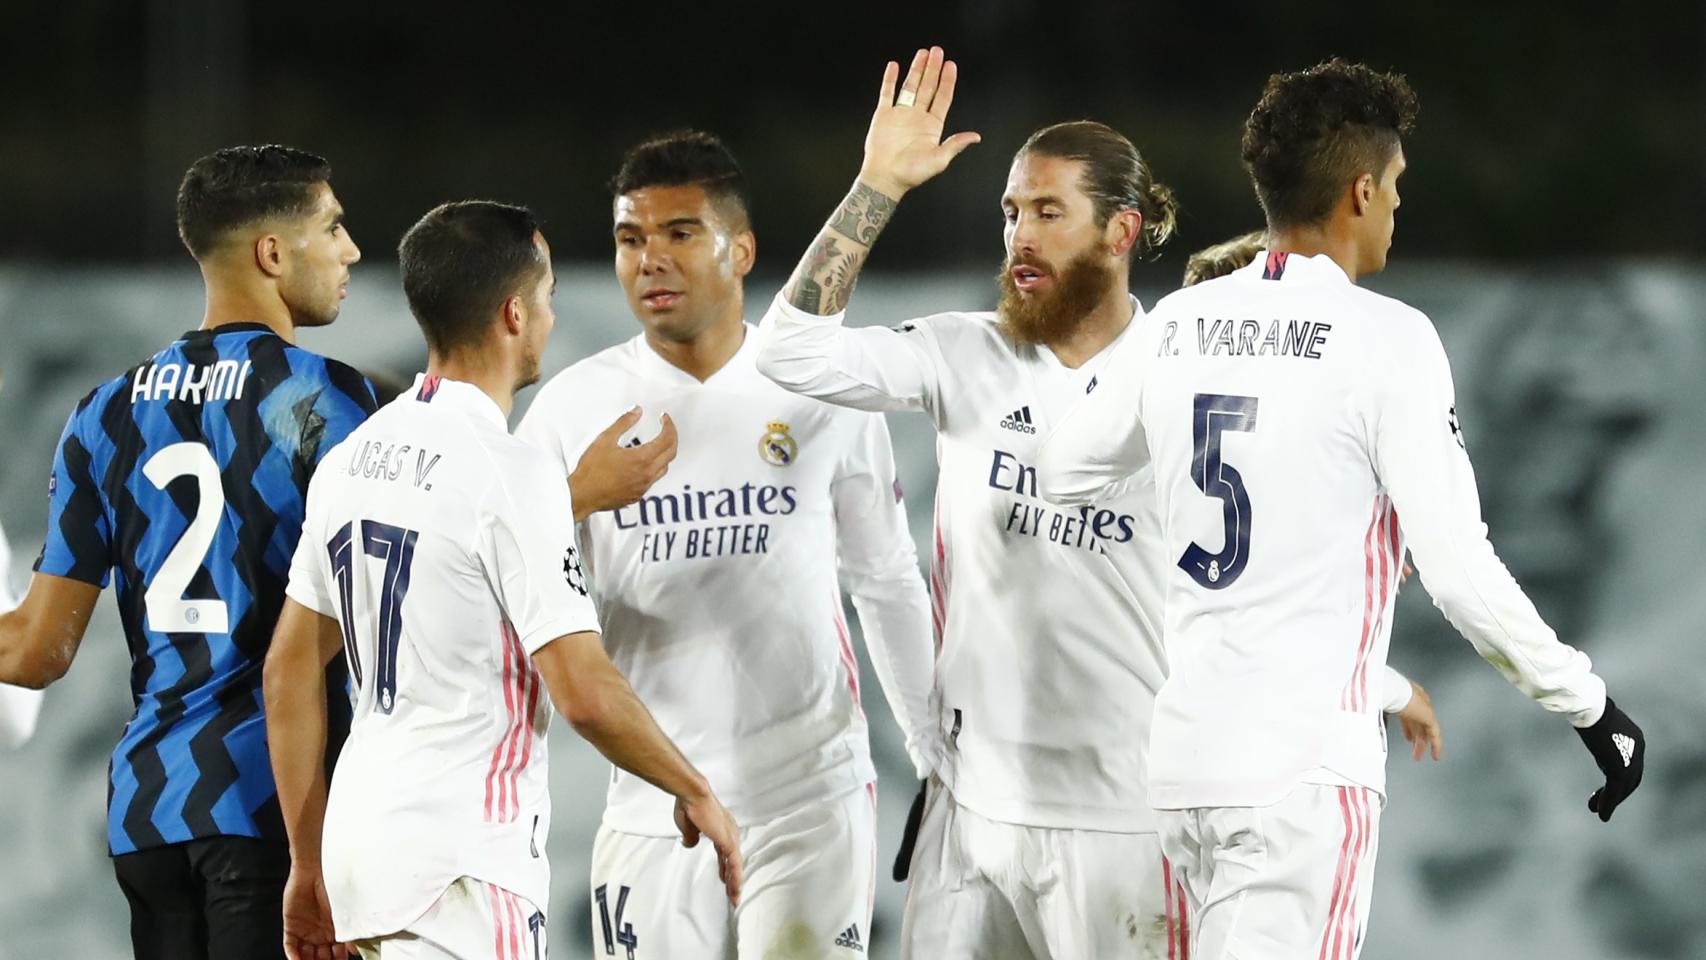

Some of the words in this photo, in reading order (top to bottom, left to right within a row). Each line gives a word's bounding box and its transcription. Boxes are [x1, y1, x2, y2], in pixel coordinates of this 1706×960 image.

[1197, 317, 1332, 359] VARANE
[1000, 419, 1036, 435] adidas
[347, 440, 411, 481] UCAS
[414, 448, 442, 491] V.
[1177, 392, 1259, 590] 5
[142, 441, 229, 634] 2
[641, 531, 677, 564] FLY
[686, 524, 770, 560] BETTER
[1006, 502, 1045, 537] FLY
[327, 519, 420, 715] 17
[594, 883, 637, 960] 14
